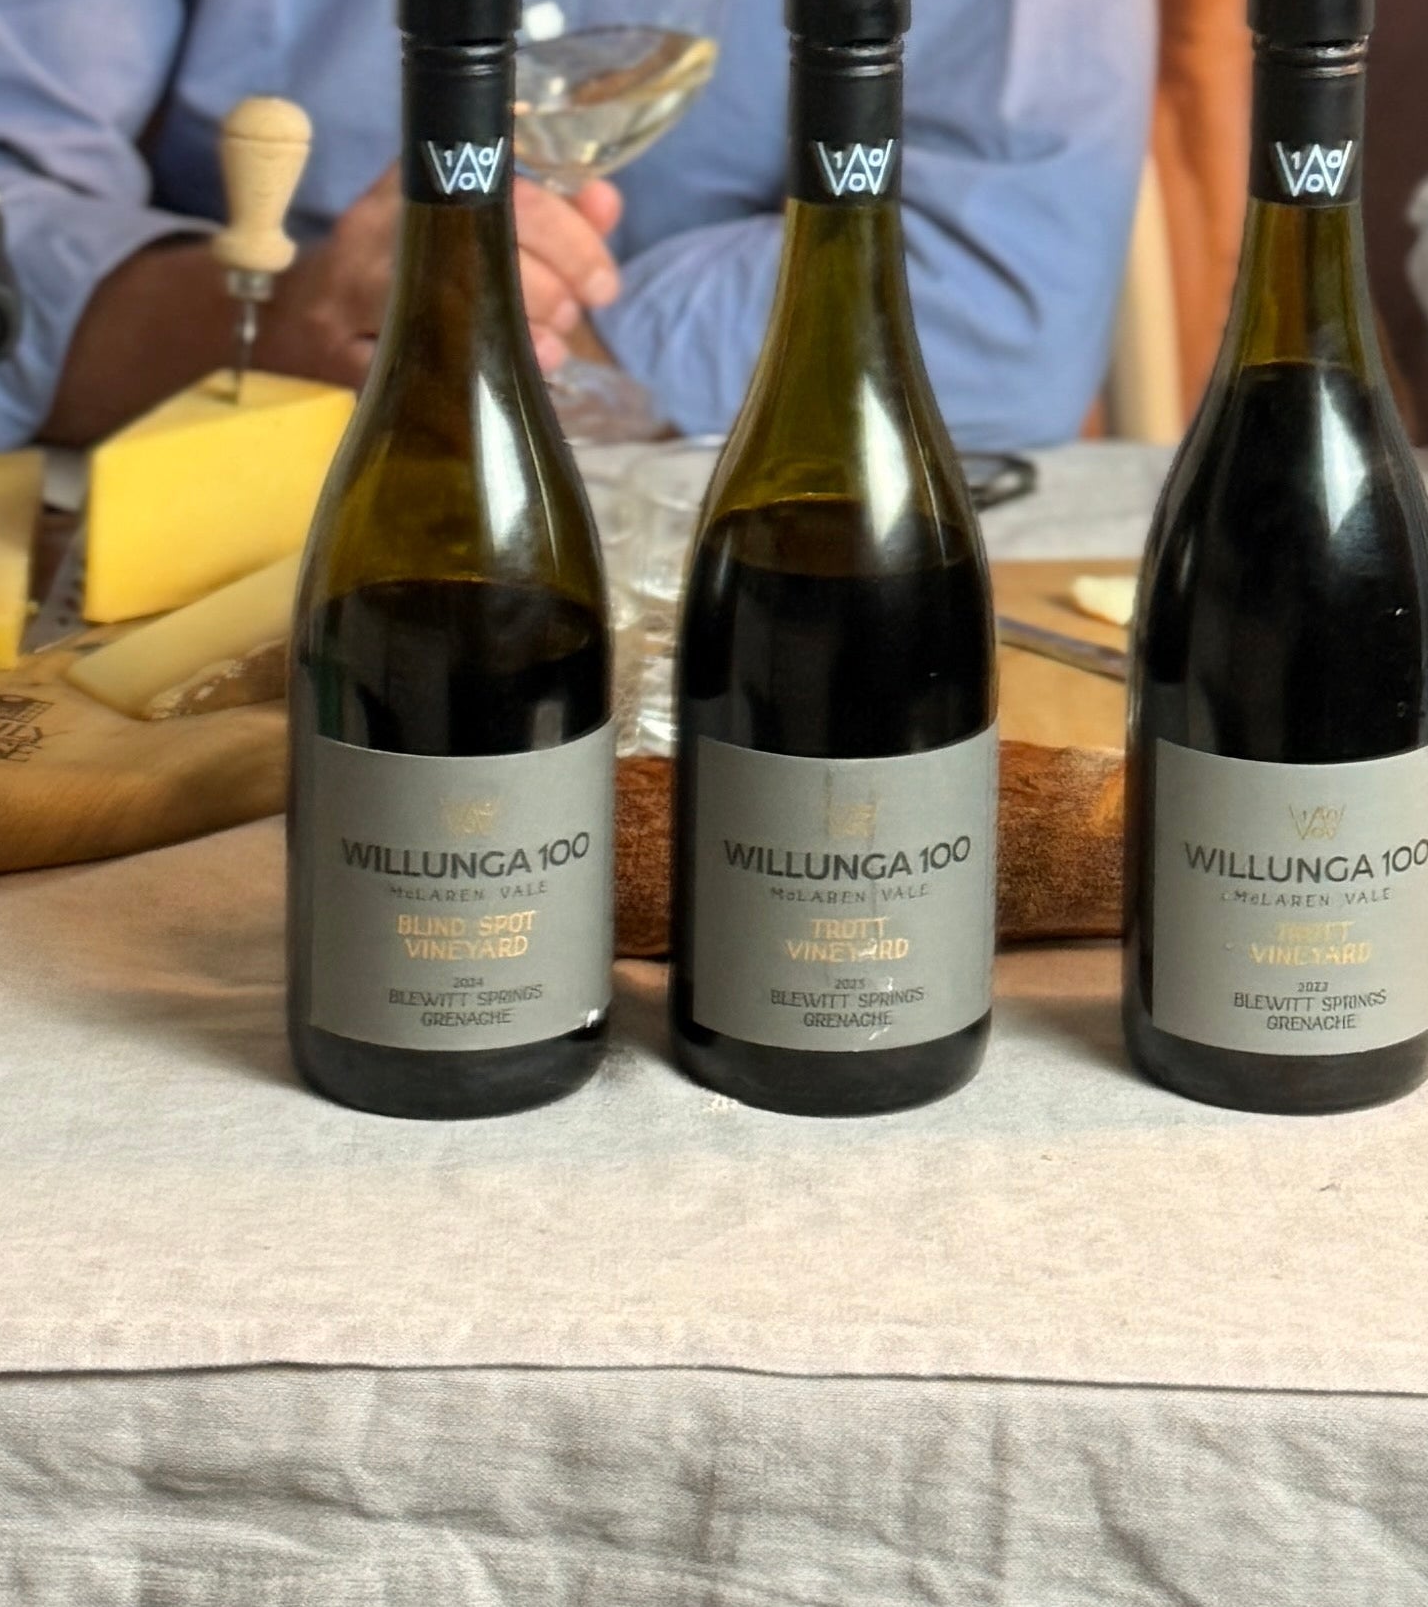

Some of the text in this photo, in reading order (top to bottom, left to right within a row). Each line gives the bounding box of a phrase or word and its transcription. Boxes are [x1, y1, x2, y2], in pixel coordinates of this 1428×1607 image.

[341, 831, 590, 880] WILLUNGA 100
[723, 834, 972, 882] WILLUNGA 100
[1183, 841, 1375, 884] WILLUNGA
[500, 880, 549, 900] VALE
[880, 883, 929, 901] VALE
[1344, 887, 1392, 905] VALE
[396, 909, 538, 937] BLIND SPOT
[810, 916, 891, 940] TROTT
[404, 935, 530, 961] VINEYARD
[785, 937, 910, 963] VINEYARD
[1246, 941, 1372, 966] VINEYARD
[388, 983, 544, 1008] BLEWITT SPRINGS
[770, 985, 926, 1009] BLEWITT SPRINGS
[1233, 988, 1388, 1012] BLEWITT SPRINGS
[421, 1008, 513, 1028] GRENACHE
[803, 1010, 893, 1029] GRENACHE
[1266, 1014, 1357, 1031] GRENACHE
